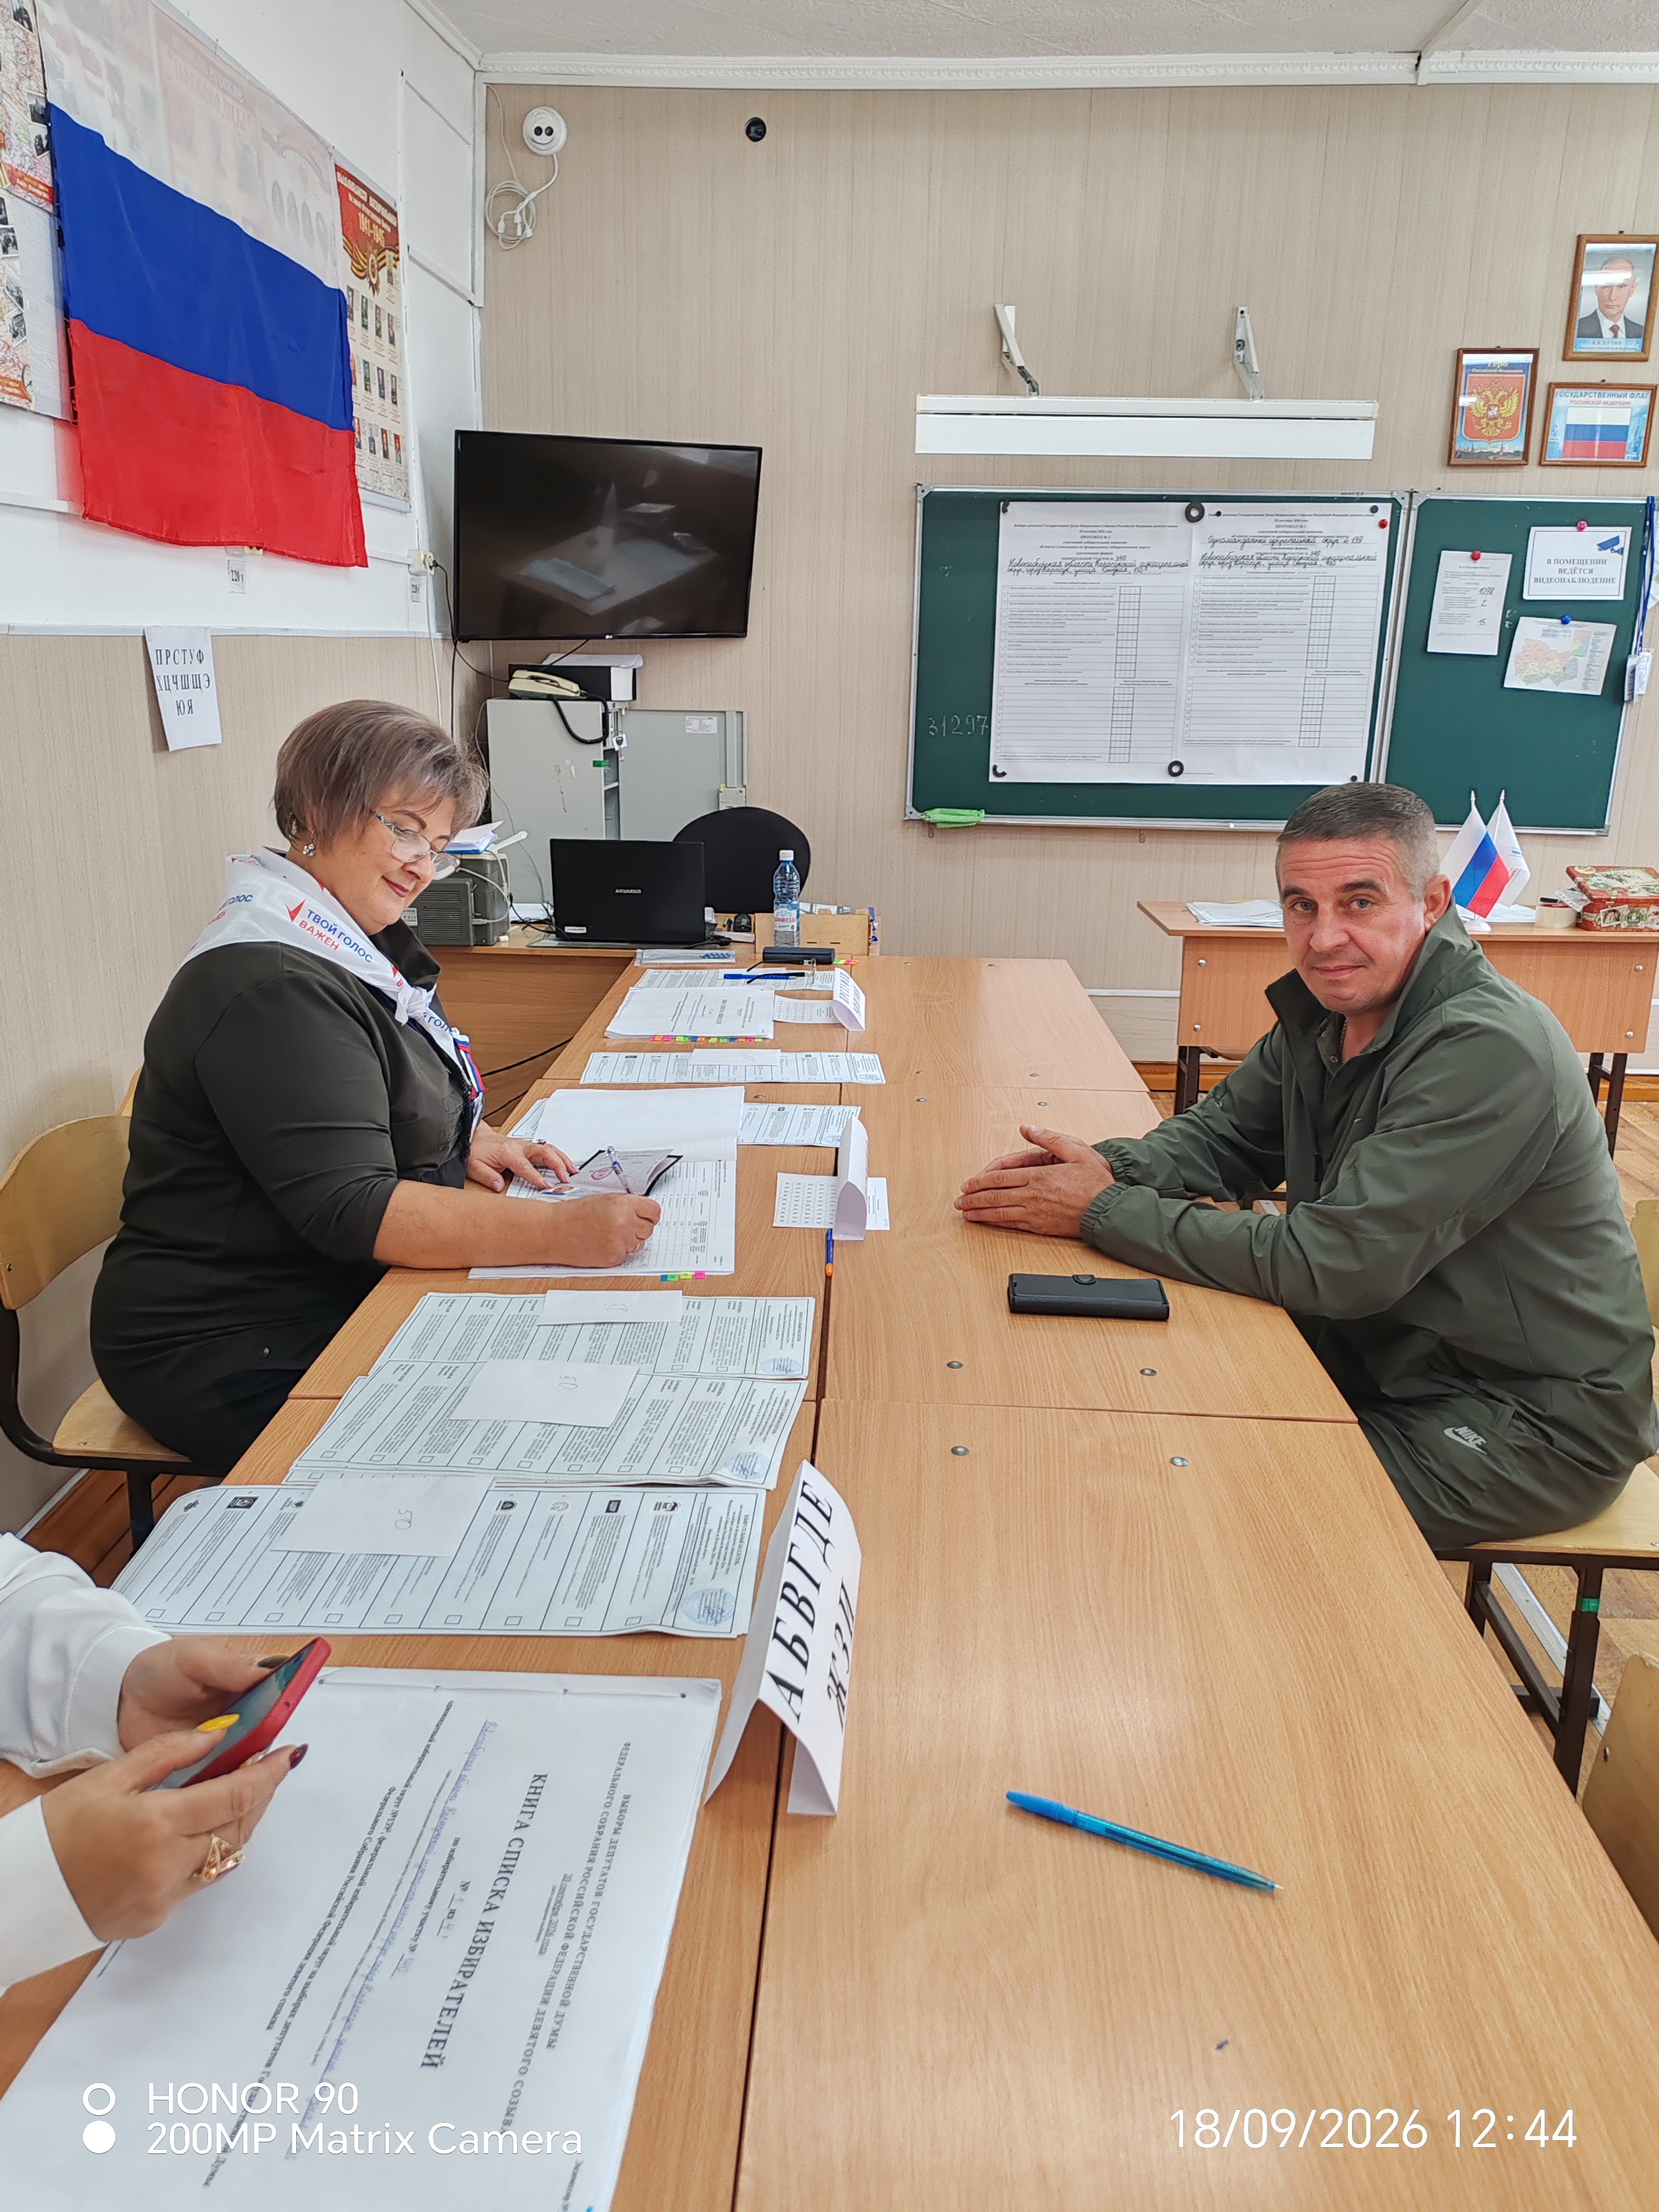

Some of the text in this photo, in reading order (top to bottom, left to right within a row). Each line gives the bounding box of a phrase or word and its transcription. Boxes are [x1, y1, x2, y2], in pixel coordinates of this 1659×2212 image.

[1487, 360, 1509, 368] Герб
[1558, 567, 1594, 575] ВЕДЁТСЯ
[155, 649, 204, 665] ПРСТУФ
[157, 673, 210, 694] ХЦЧШЩЭ
[928, 715, 989, 737] 31297
[299, 920, 340, 950] ВАЖЕН
[308, 909, 373, 963] ТВОЙ ГОЛОС
[1454, 1425, 1487, 1446] NIKE
[765, 1479, 835, 1724] АБВГДЕ
[403, 1743, 431, 1788] избирательный
[603, 1741, 631, 1808] ФЕДЕРАЛЬНОГО
[367, 1786, 396, 1835] Федерального
[393, 1789, 407, 1808] округ
[349, 1836, 372, 1873] Собрания
[451, 1836, 460, 1846] по
[586, 1811, 609, 1864] СОБРАНИЯ
[357, 1835, 386, 1887] федеральный
[425, 1847, 456, 1909] избирательному
[326, 1875, 355, 1919] Российской
[459, 1881, 471, 1892] №
[563, 1866, 593, 1939] РОССИЙСКОЙ
[326, 1888, 361, 1946] избирательный
[410, 1910, 430, 1942] участку
[421, 1773, 548, 2068] КНИГА СПИСКА ИЗБИРАТЕЛЕЙ
[446, 1908, 457, 1920] из
[545, 1794, 631, 2049] ВЫБОРЫ ДЕПУТАТОВ ГОСУДАРСТВЕННОЙ ДУМЫ
[303, 1919, 331, 1961] Федерации
[314, 1946, 330, 1969] округ
[306, 1969, 318, 1980] на
[539, 1943, 569, 2005] ФЕДЕРАЦИИ
[265, 1998, 286, 2031] созыва
[287, 1981, 312, 2018] выборах
[264, 2020, 292, 2068] депутатов
[518, 2008, 546, 2075] ДЕВЯТОГО
